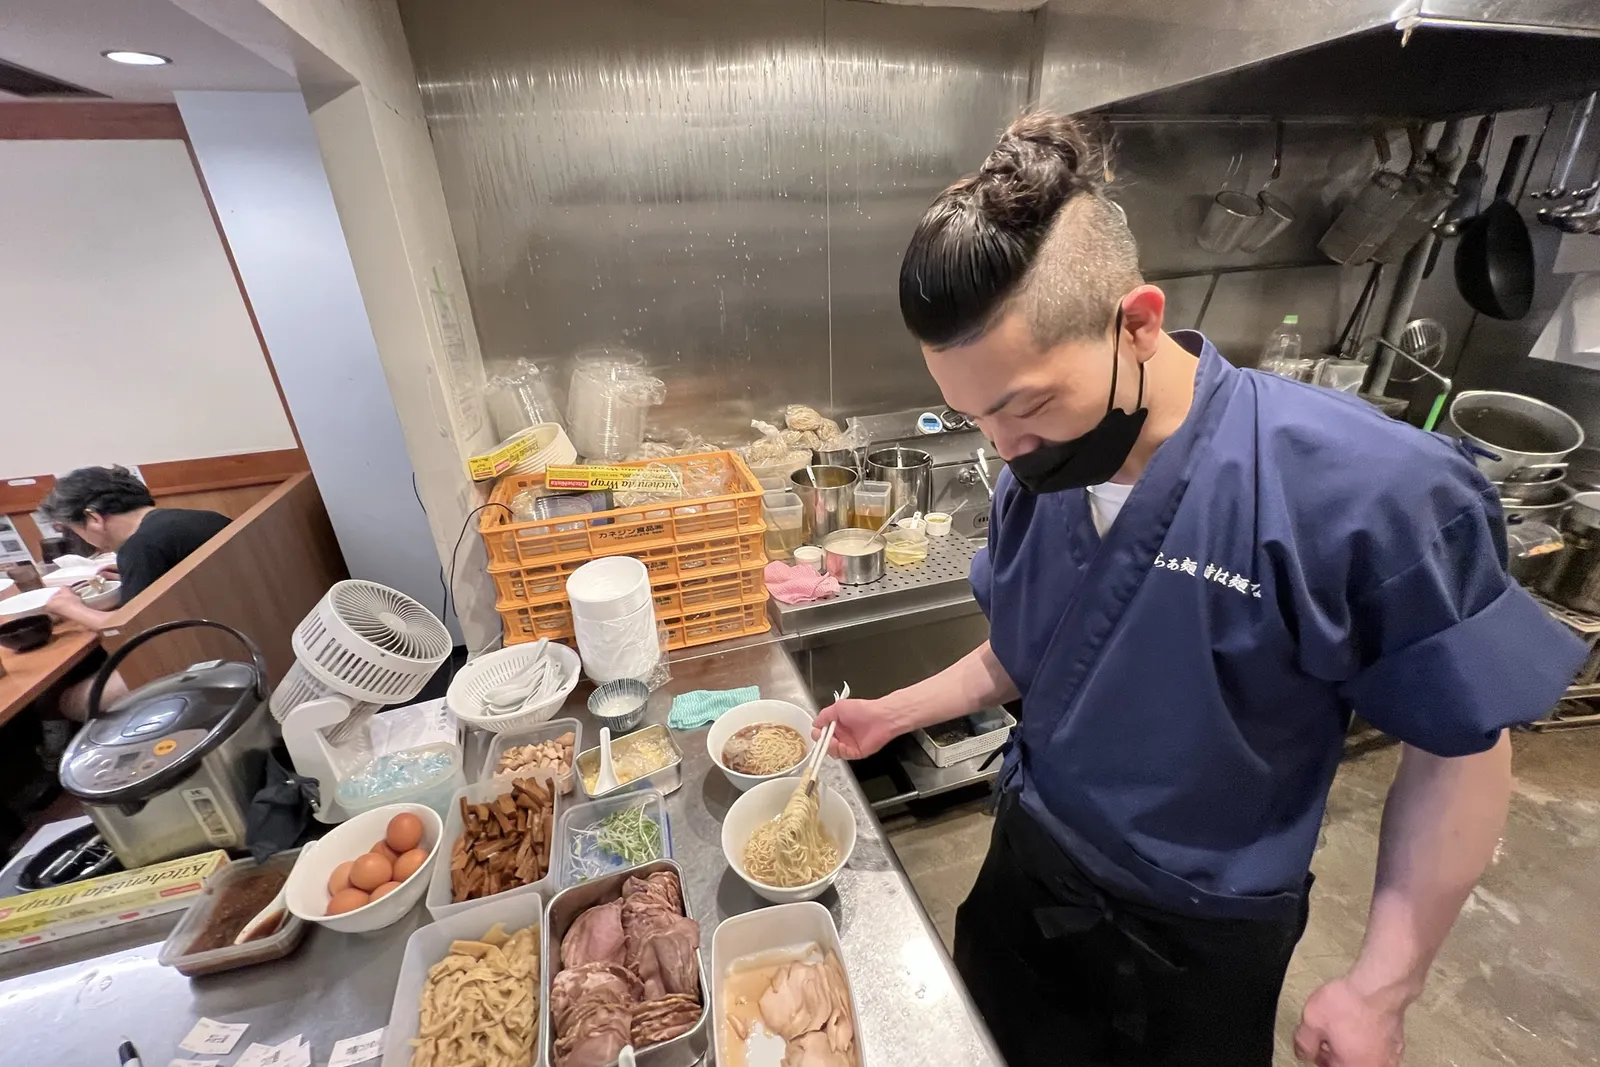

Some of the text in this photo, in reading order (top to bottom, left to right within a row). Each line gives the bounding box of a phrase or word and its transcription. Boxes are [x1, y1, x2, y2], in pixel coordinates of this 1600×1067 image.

[590, 478, 619, 490] Wrap
[83, 862, 207, 896] Kitchenista
[17, 893, 74, 913] Wrap
